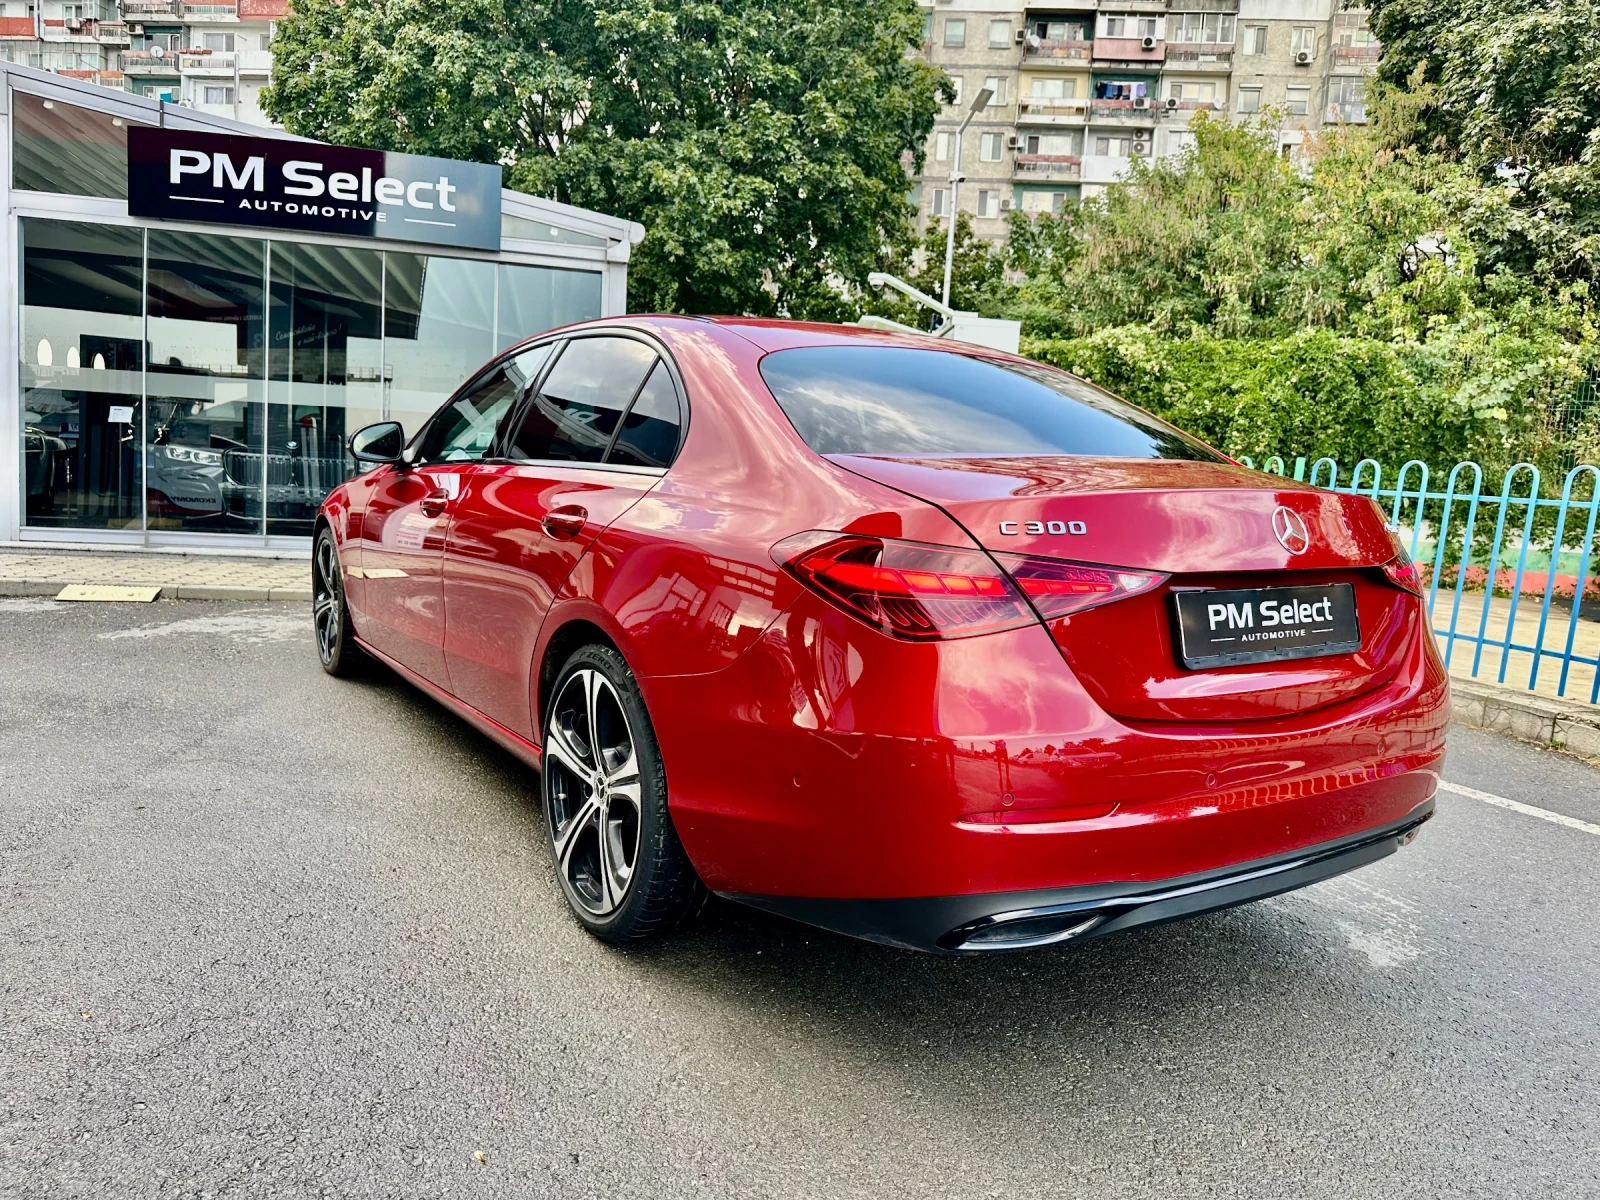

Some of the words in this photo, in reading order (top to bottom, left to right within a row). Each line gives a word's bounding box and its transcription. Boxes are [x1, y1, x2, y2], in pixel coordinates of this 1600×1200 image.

[169, 148, 264, 192] PM
[282, 160, 456, 213] Select
[238, 198, 387, 223] AUTOMOTIVE
[999, 520, 1018, 536] C
[1024, 520, 1087, 536] 300
[1207, 603, 1254, 631] PM
[1261, 596, 1334, 627] Select
[1240, 628, 1306, 643] AUTOMOTIVE
[586, 652, 611, 669] ZERO
